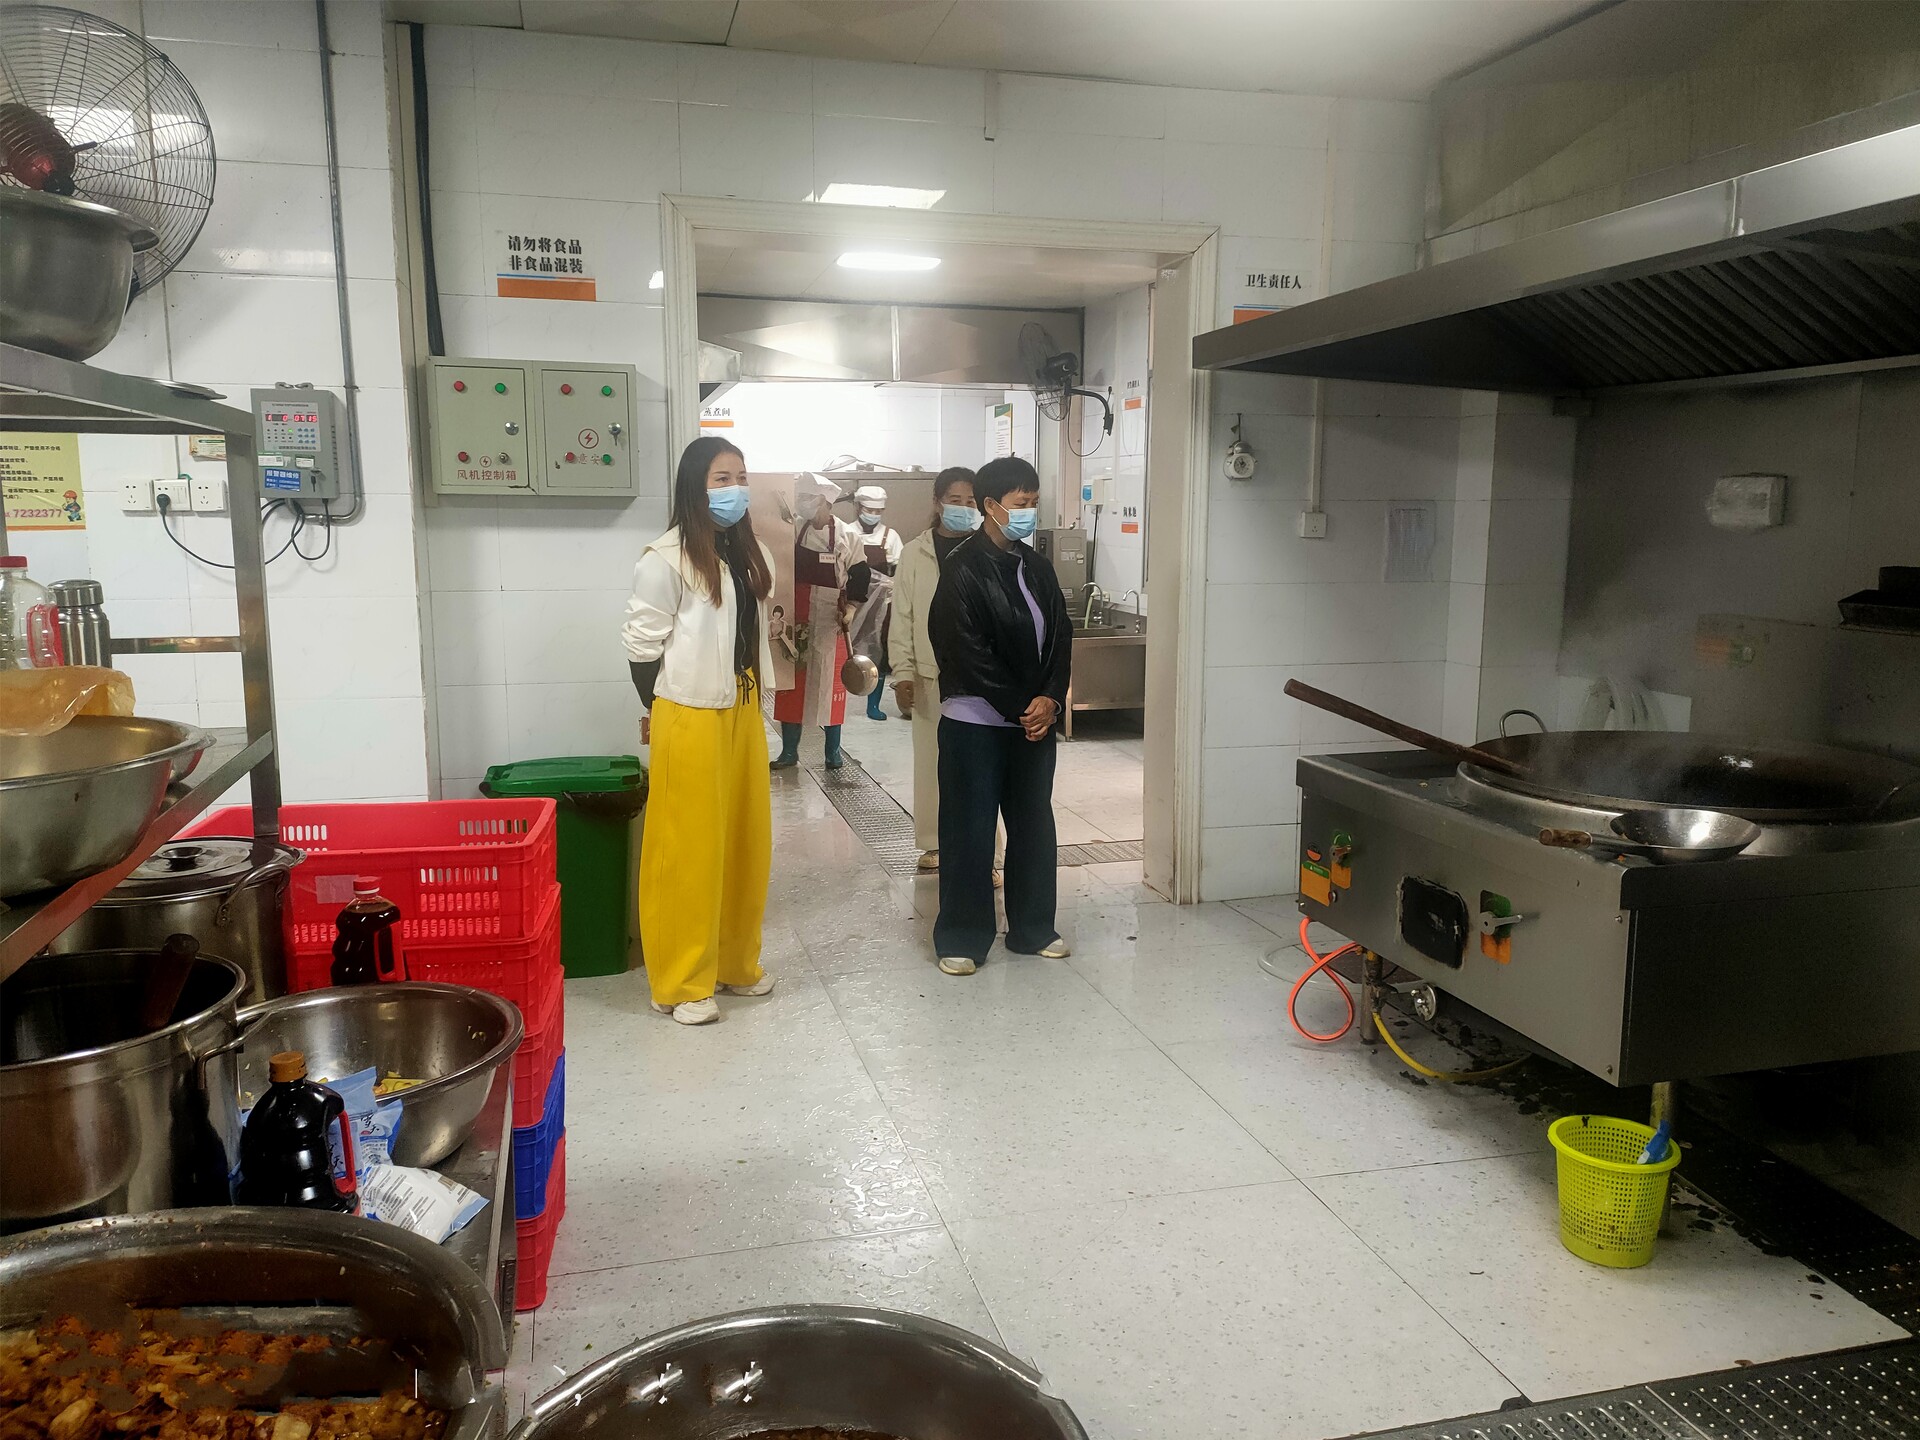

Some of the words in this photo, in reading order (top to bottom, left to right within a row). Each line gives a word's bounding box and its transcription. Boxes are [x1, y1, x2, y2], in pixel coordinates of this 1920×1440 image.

[508, 235, 582, 254] 请勿将食品
[508, 255, 583, 274] 非食品混装
[1245, 273, 1302, 289] 卫生责任人
[457, 469, 517, 481] 风机控制箱
[13, 509, 63, 518] 7232377
